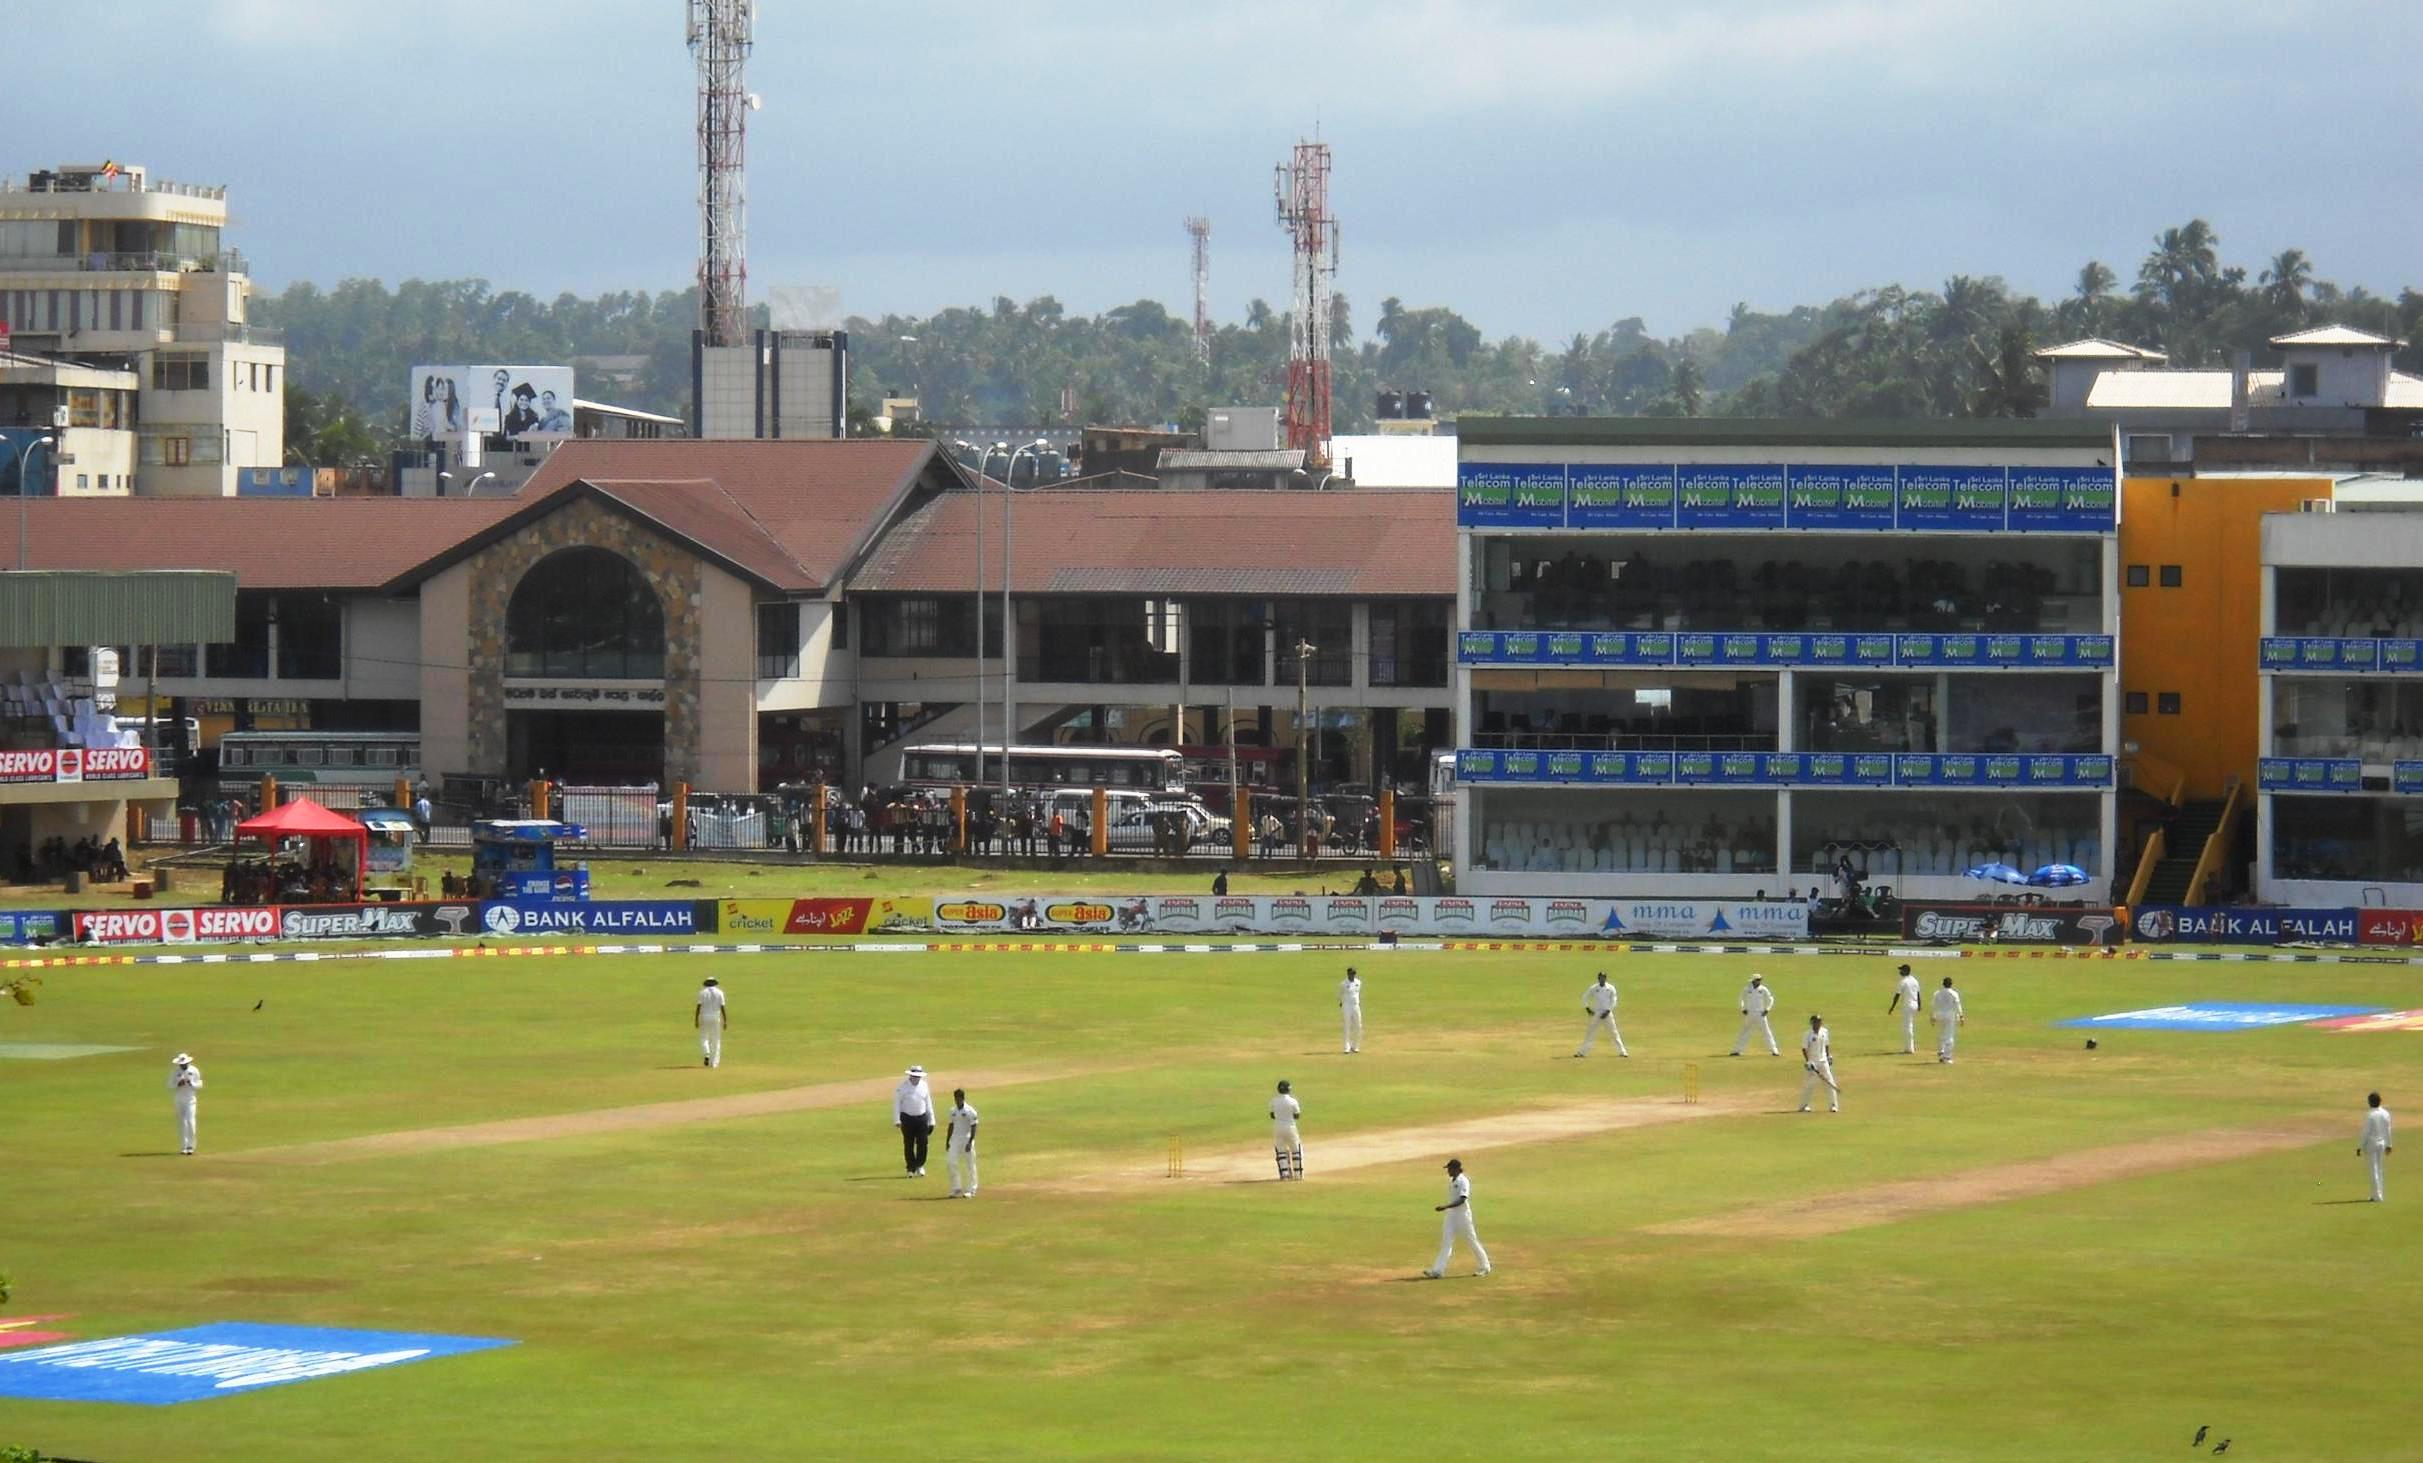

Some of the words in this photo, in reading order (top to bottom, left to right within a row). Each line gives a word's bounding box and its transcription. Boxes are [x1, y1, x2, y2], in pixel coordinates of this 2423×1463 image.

[1460, 474, 1510, 488] Telecom
[1513, 475, 1563, 489] Telecom
[1570, 475, 1620, 489] Telecom
[1622, 476, 1672, 490] Telecom
[1680, 475, 1730, 489] Telecom
[1732, 475, 1782, 489] Telecom
[1790, 476, 1840, 490] Telecom
[1843, 476, 1893, 490] Telecom
[1900, 476, 1950, 490] Telecom
[1953, 477, 2003, 491] Telecom
[2010, 477, 2060, 491] Telecom
[2063, 477, 2113, 491] Telecom
[86, 750, 144, 770] SERVO
[524, 911, 585, 926] BANK
[593, 911, 692, 926] ALFALAH
[1633, 904, 1696, 919] mma
[1739, 906, 1803, 920] mma
[200, 912, 273, 934] SERVO
